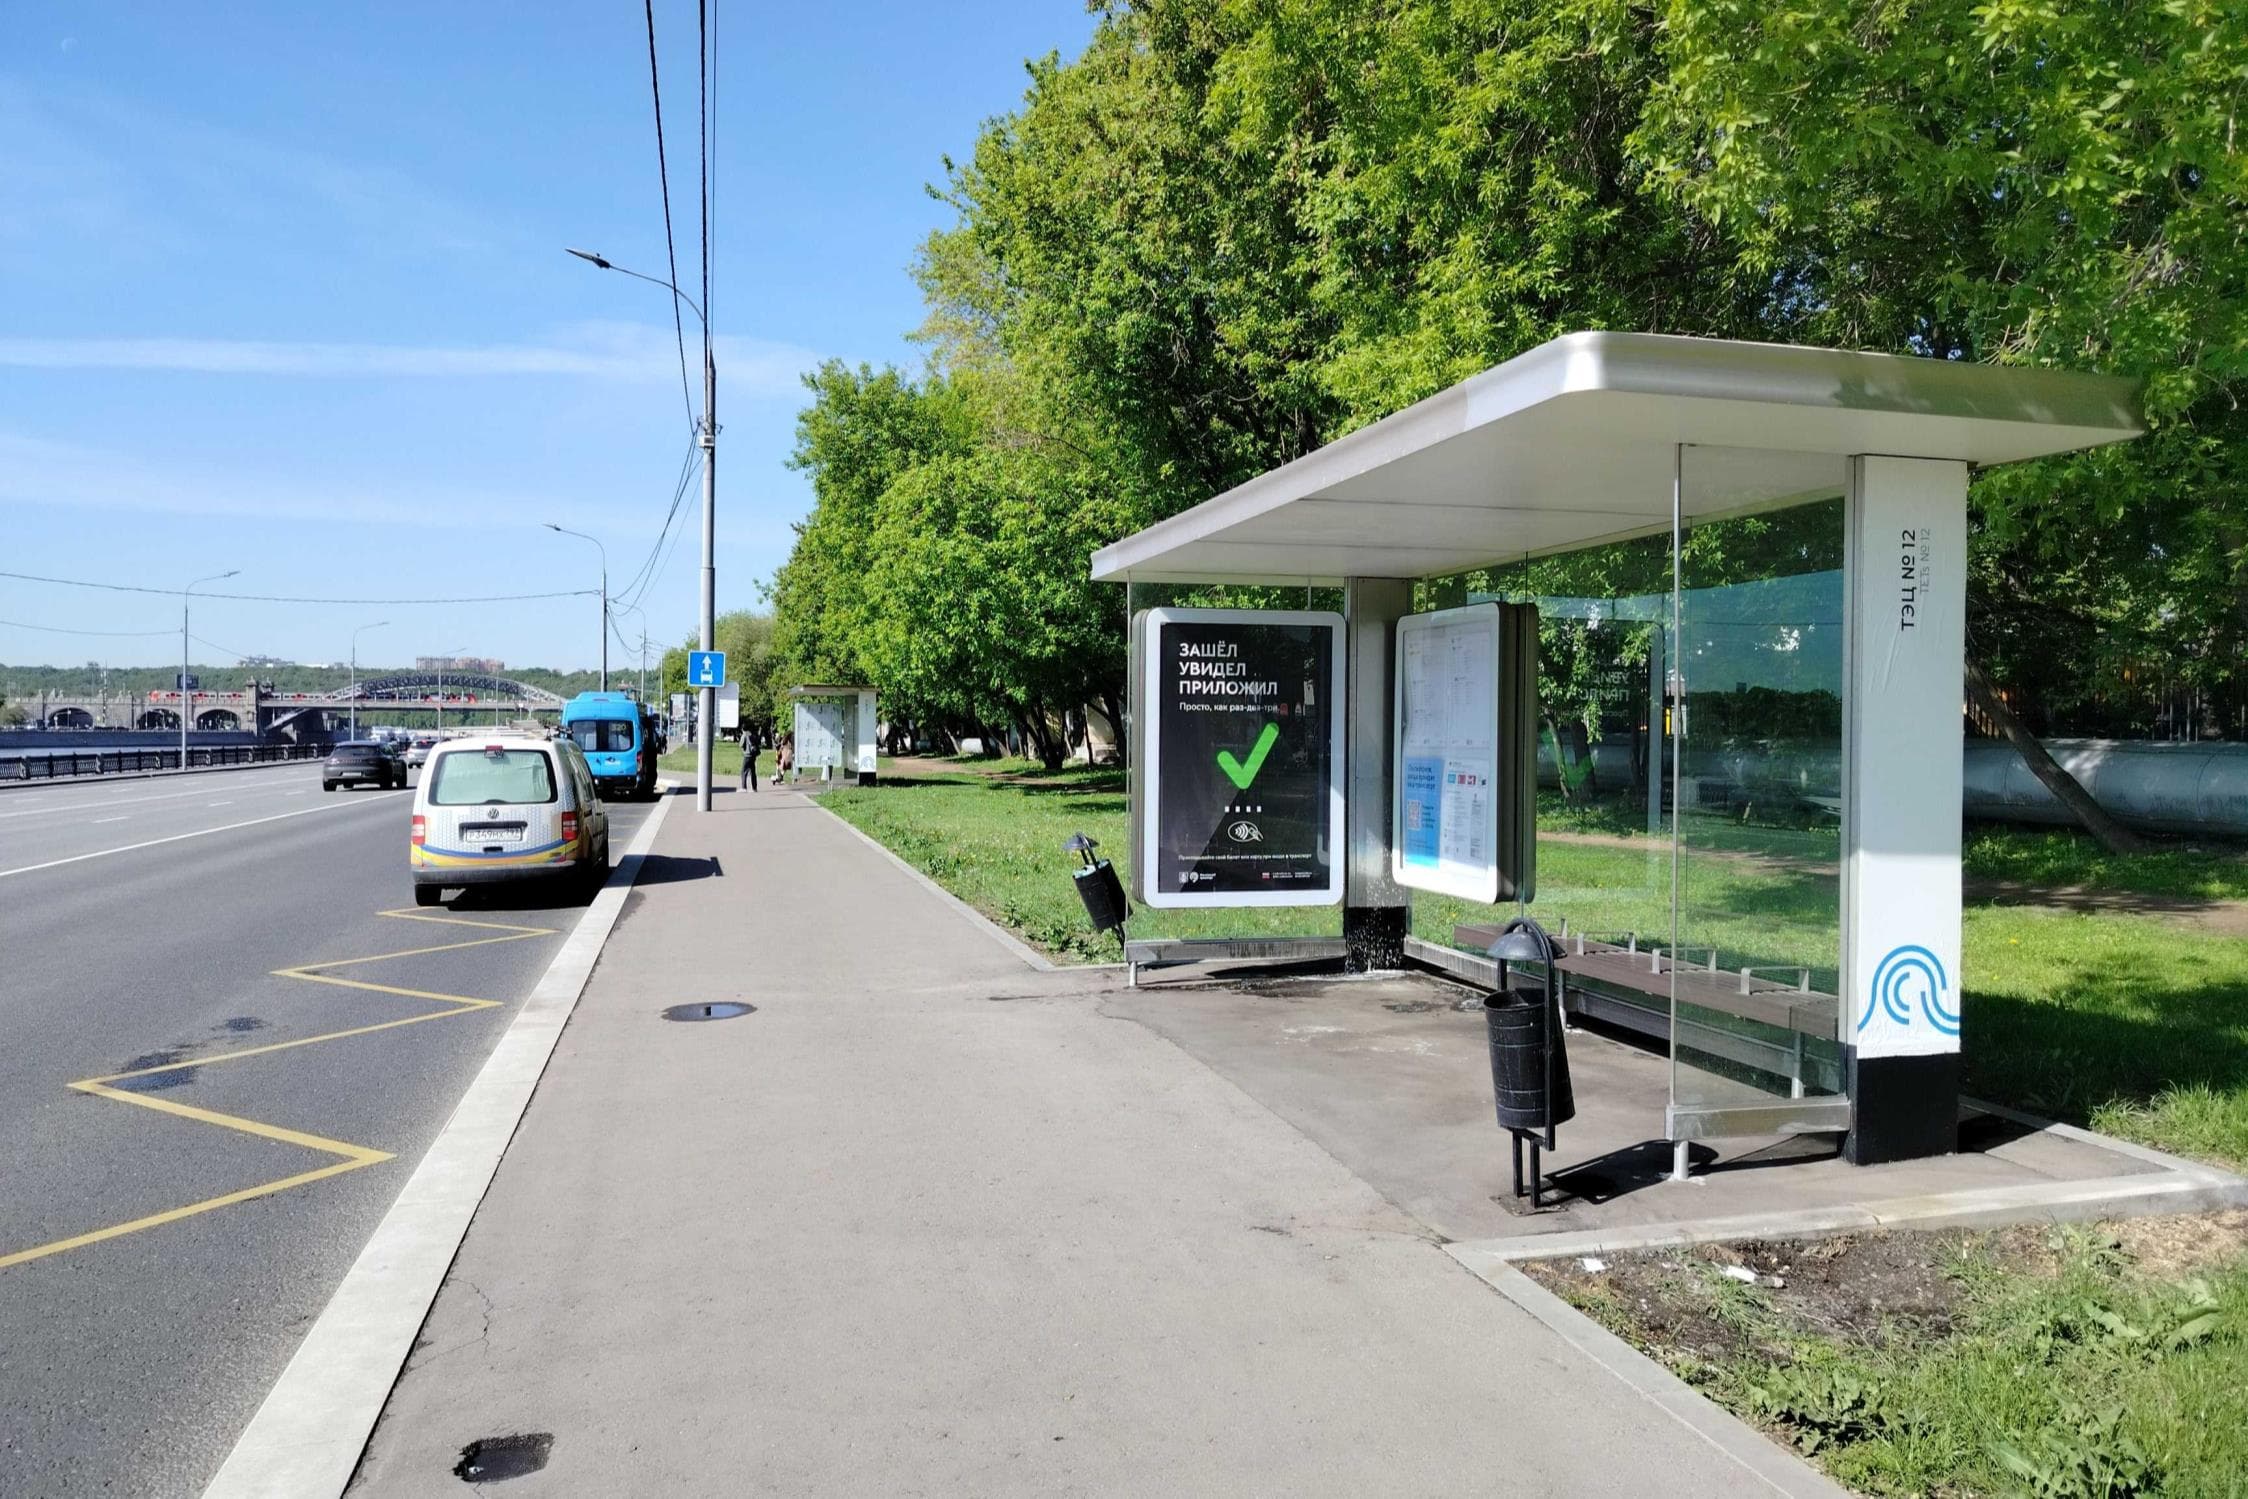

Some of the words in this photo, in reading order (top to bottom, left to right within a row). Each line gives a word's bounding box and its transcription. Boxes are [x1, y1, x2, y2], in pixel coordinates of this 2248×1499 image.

[1901, 530, 1916, 549] 12
[1901, 555, 1915, 580] №
[1901, 586, 1917, 631] ТЭЦ
[1179, 640, 1238, 657] ЗАШЁЛ
[1179, 662, 1246, 678] УВИДЕЛ
[1179, 681, 1278, 695] ПРИЛОЖИЛ
[1179, 701, 1212, 712] Просто,
